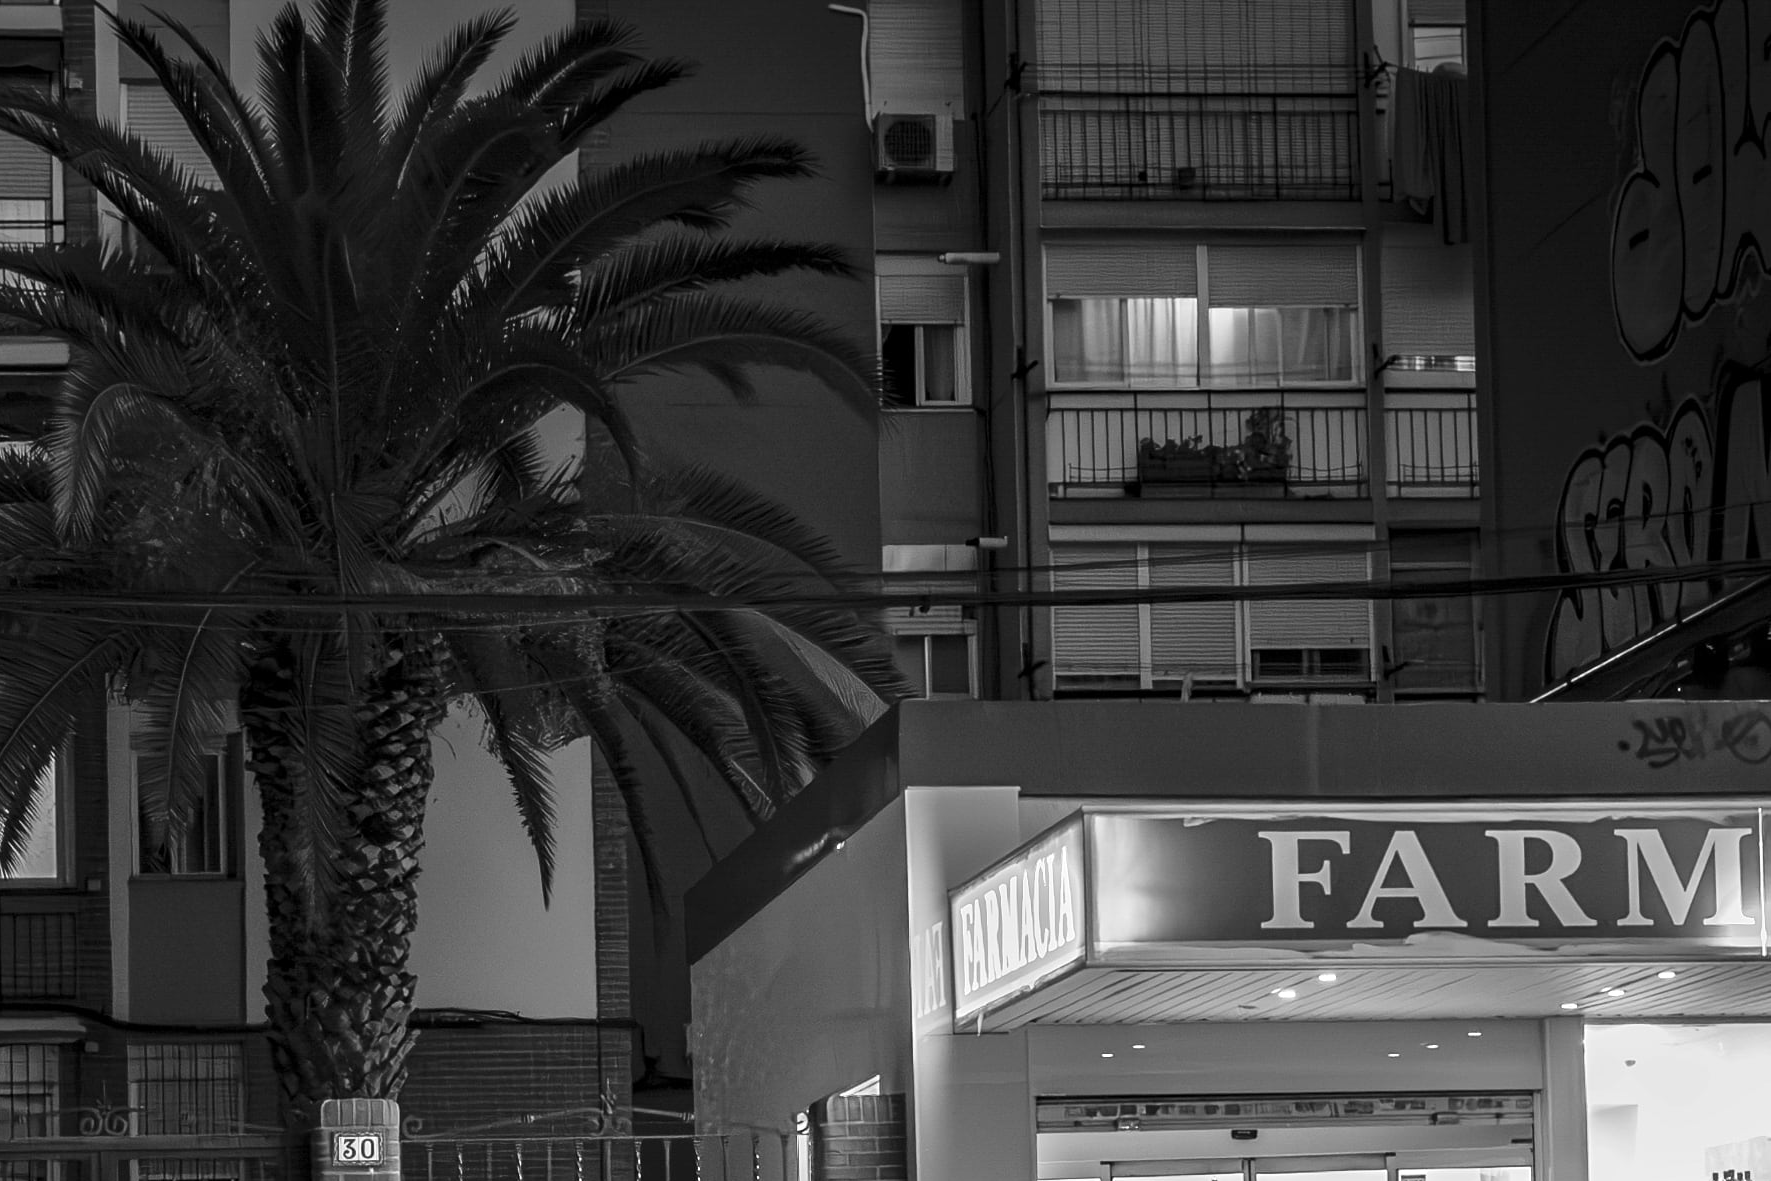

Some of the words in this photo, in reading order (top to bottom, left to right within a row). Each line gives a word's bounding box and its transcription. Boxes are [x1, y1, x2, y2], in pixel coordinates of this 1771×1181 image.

[960, 846, 1075, 996] FARMACIA
[1257, 827, 1756, 930] FARM
[342, 1137, 376, 1160] 30
